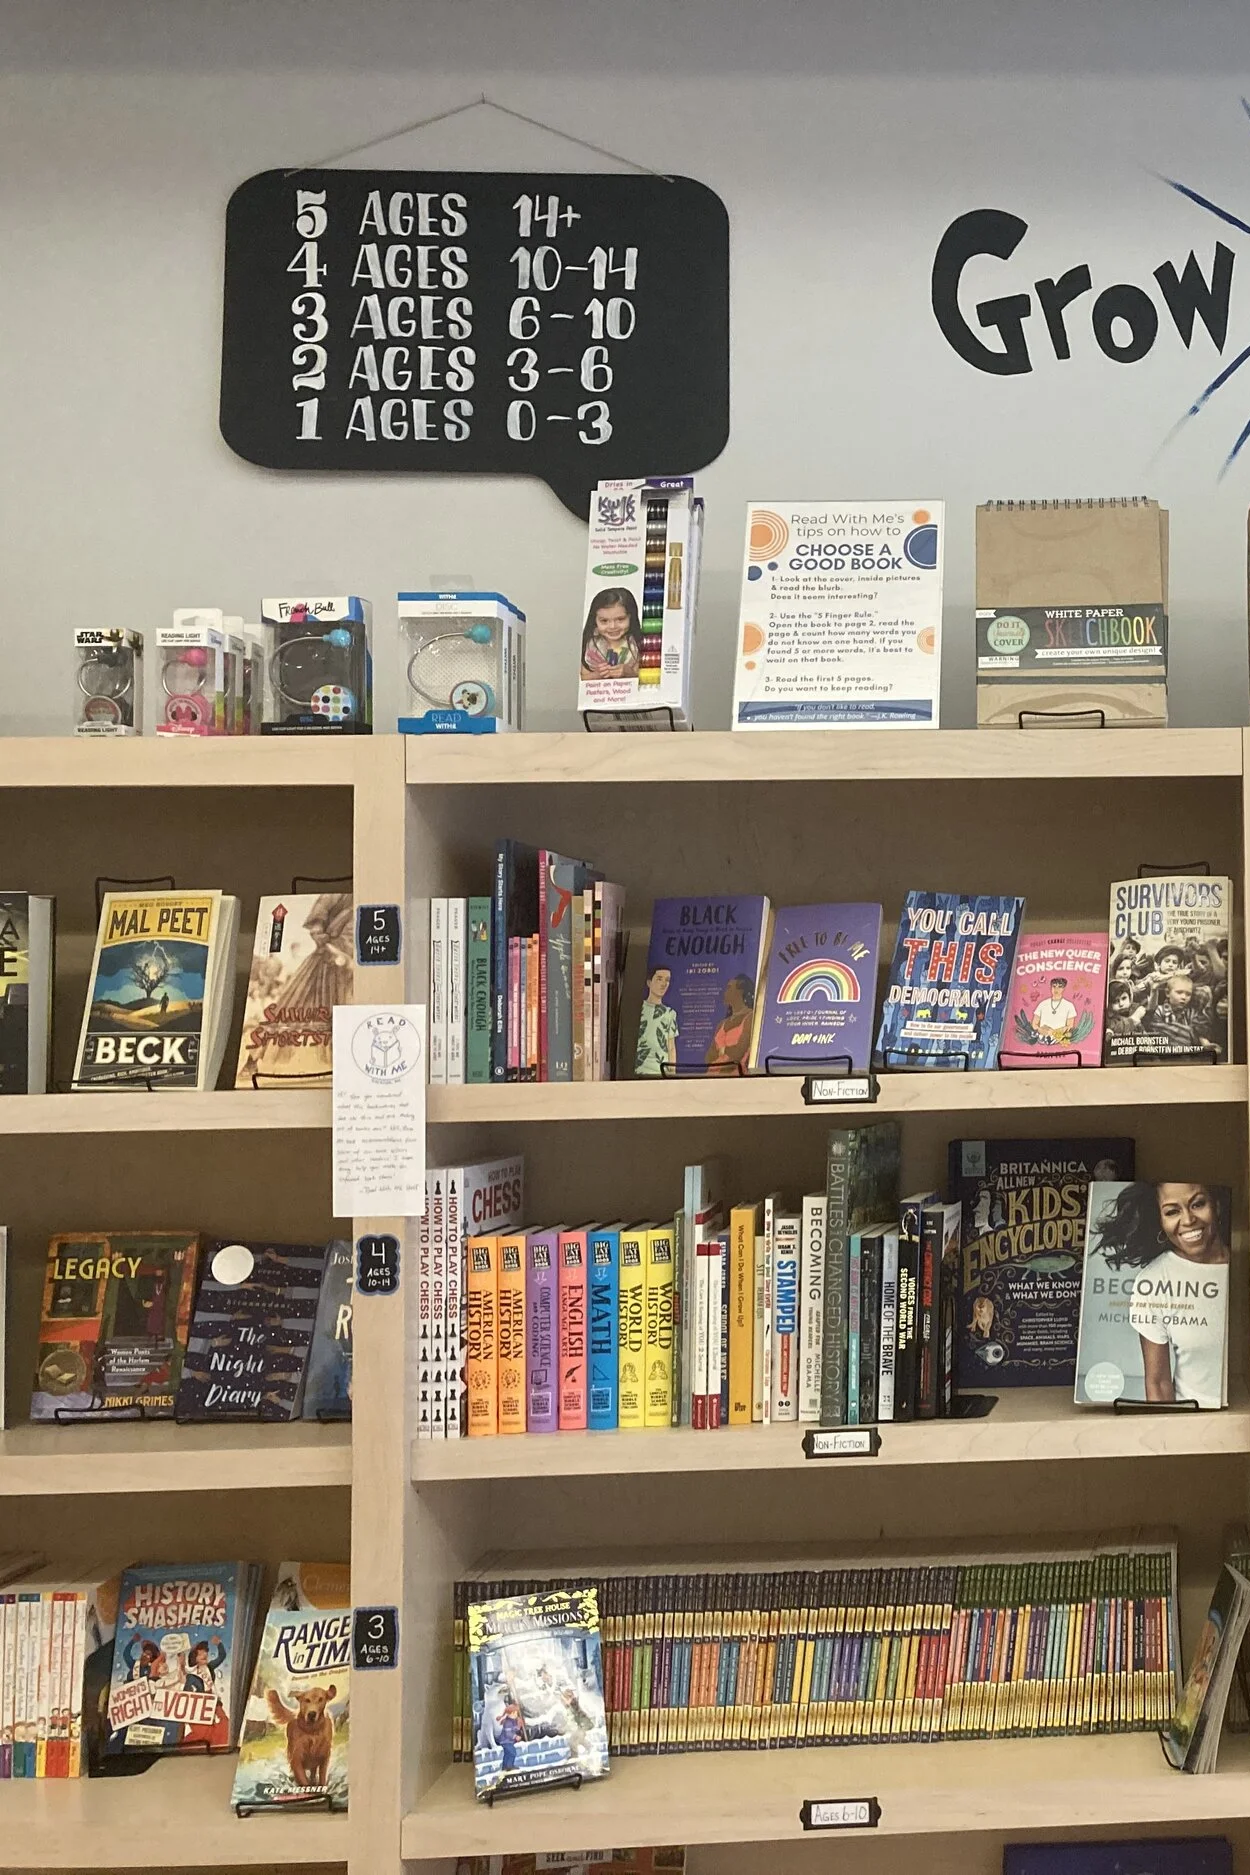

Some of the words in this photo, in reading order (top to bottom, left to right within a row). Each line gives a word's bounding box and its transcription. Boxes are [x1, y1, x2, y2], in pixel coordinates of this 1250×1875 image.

[295, 189, 328, 238] 5
[359, 191, 468, 237] AGES
[513, 194, 581, 237] 14+
[287, 242, 328, 288] 4
[351, 243, 469, 289] AGES
[510, 246, 638, 291] 10-14
[291, 292, 329, 343] 3
[350, 294, 473, 340] AGES
[291, 343, 328, 391] 2
[349, 345, 476, 392] AGES
[295, 397, 323, 440] 1
[345, 395, 474, 441] AGES
[791, 514, 827, 524] Read
[834, 513, 867, 524] With
[872, 513, 905, 524] Me's
[797, 527, 823, 538] tips
[828, 527, 846, 536] on
[851, 525, 882, 536] how
[886, 526, 901, 536] to
[796, 544, 873, 556] CHOOSE
[879, 544, 892, 556] A
[789, 558, 845, 570] GOOD
[851, 557, 903, 570] BOOK
[279, 602, 314, 619] French
[314, 602, 336, 615] Bull
[1045, 610, 1082, 618] WHITE
[1085, 609, 1124, 618] PAPER
[1116, 882, 1223, 910] SURVIVORS
[108, 910, 151, 939] MAL
[158, 907, 209, 934] PEET
[373, 910, 386, 930] 5
[680, 906, 738, 925] BLACK
[908, 908, 953, 934] YOU
[960, 911, 1014, 936] CALL
[1115, 913, 1164, 938] CLUB
[366, 935, 390, 945] AGES
[370, 945, 387, 955] 14+
[666, 934, 746, 956] ENOUGH
[904, 938, 1004, 984] THIS
[1018, 951, 1046, 962] THE
[1047, 950, 1067, 960] NEW
[1068, 950, 1102, 960] QUEER
[1017, 961, 1102, 976] CONSCIENCE
[889, 985, 1002, 1008] DEMOCRACY?
[367, 1017, 406, 1029] READ
[94, 1036, 187, 1065] BECK
[365, 1064, 387, 1076] WITH
[391, 1061, 408, 1075] ME
[1000, 1161, 1088, 1175] BRITANNICA
[371, 1242, 386, 1265] 4
[810, 1206, 823, 1300] BECOMING
[53, 1257, 142, 1280] LEGACY
[366, 1267, 391, 1278] AGES
[367, 1277, 391, 1288] 10-14
[1092, 1278, 1220, 1299] BECOMING
[776, 1260, 797, 1334] STAMPED
[469, 1290, 482, 1363] HISTORY
[483, 1289, 494, 1361] AMERICAN
[568, 1284, 584, 1358] ENGLISH
[591, 1283, 612, 1355] MATH
[619, 1289, 628, 1350] HISTORY
[629, 1283, 643, 1353] WORLD
[1099, 1312, 1158, 1325] MICHELLE
[1162, 1315, 1208, 1327] OBAMA
[238, 1326, 267, 1344] The
[205, 1382, 263, 1408] Diary
[134, 1581, 226, 1607] HISTORY
[124, 1606, 227, 1628] SMASHERS
[368, 1616, 384, 1639] 3
[360, 1645, 389, 1655] AGES
[365, 1654, 390, 1664] 6-10
[111, 1701, 152, 1726] RIGHT
[163, 1694, 216, 1722] VOTE
[263, 1785, 286, 1795] KATE
[288, 1784, 329, 1794] MESSNER
[841, 1805, 868, 1821] 6-10
